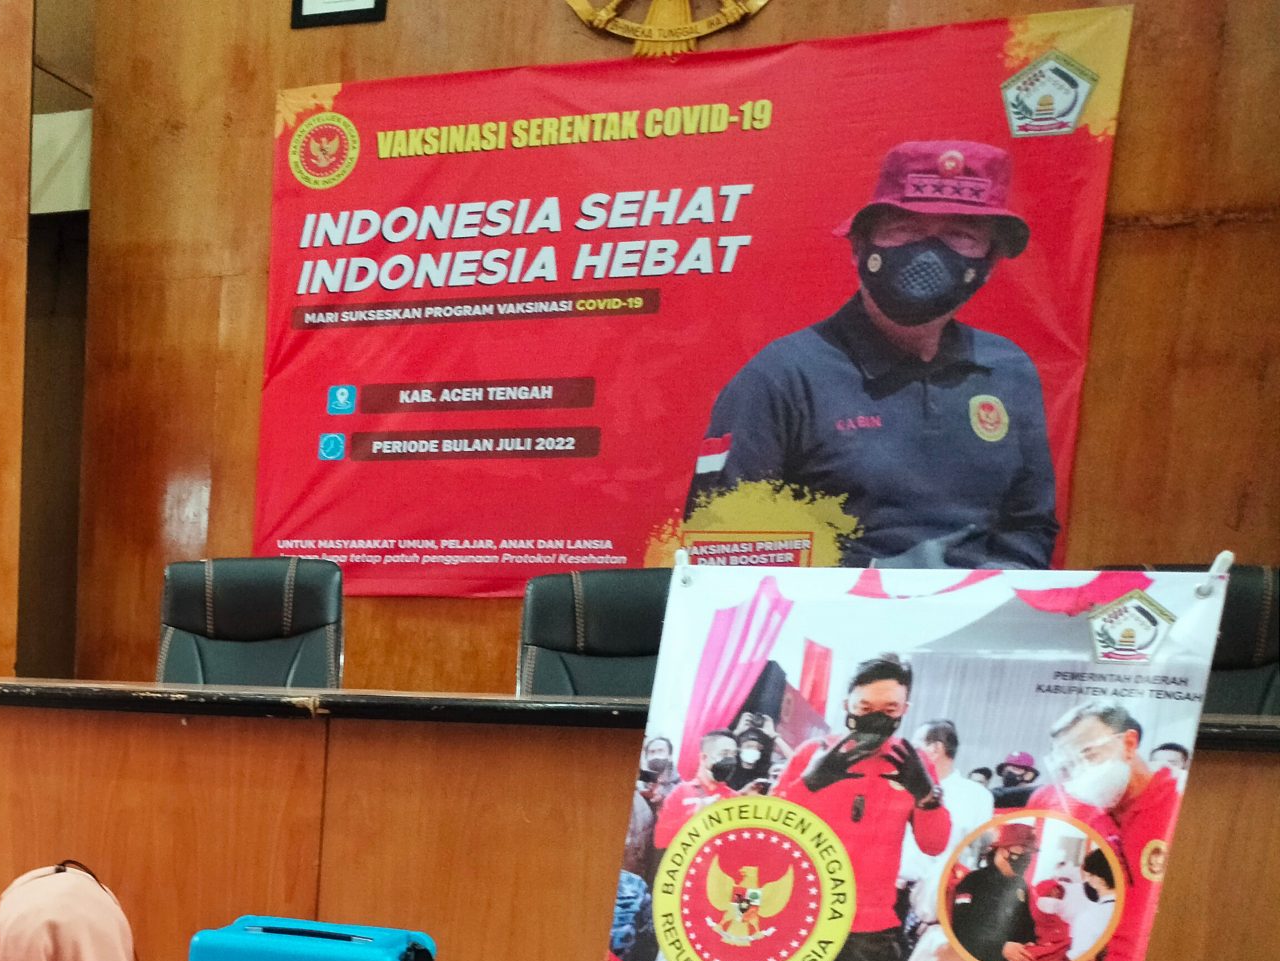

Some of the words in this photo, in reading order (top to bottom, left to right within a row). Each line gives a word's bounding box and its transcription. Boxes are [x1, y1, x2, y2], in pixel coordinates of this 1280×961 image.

[377, 121, 507, 158] VAKSINASI
[512, 110, 641, 148] SERENTAK
[644, 99, 773, 138] COVID-19
[298, 197, 562, 248] INDONESIA
[575, 184, 754, 231] SEHAT
[296, 246, 559, 295] INDONESIA
[572, 235, 752, 280] HEBAT
[304, 311, 339, 324] MARI
[340, 306, 422, 322] SUKSESKAN
[424, 303, 494, 318] PROGRAM
[497, 300, 573, 315] VAKSINASI
[575, 296, 644, 312] COVID-19
[399, 390, 436, 403] KAB.
[439, 387, 484, 402] ACEH
[487, 385, 554, 401] TENGAH
[372, 440, 439, 454] PERIODE
[442, 438, 493, 452] BULAN
[495, 437, 532, 451] JULI
[534, 437, 576, 450] 2022
[276, 539, 317, 549] UNTUK
[318, 539, 396, 549] MASYARAKAT
[398, 539, 438, 551] UMUM,
[440, 539, 497, 550] PELAJAR,
[499, 539, 535, 549] ANAK
[537, 539, 565, 549] DAN
[566, 539, 613, 550] LANSIA
[756, 539, 812, 552] PRIMIER
[321, 553, 347, 564] lupa
[349, 553, 382, 564] tetap
[383, 553, 421, 565] patuh
[422, 554, 499, 565] penggunaan
[501, 553, 557, 563] Protokol
[558, 553, 628, 564] Kesehatan
[697, 557, 726, 566] DAN
[729, 553, 794, 566] BOOSTER
[1053, 671, 1131, 684] PEMERINTAH
[1134, 674, 1189, 687] DAERAH
[1036, 683, 1107, 696] KABUPATEN
[1111, 688, 1145, 699] ACEH
[1149, 689, 1202, 702] TENGAH
[662, 827, 701, 895] BADAN
[703, 804, 812, 834] INTELIJEN
[811, 832, 848, 921] NEGARA
